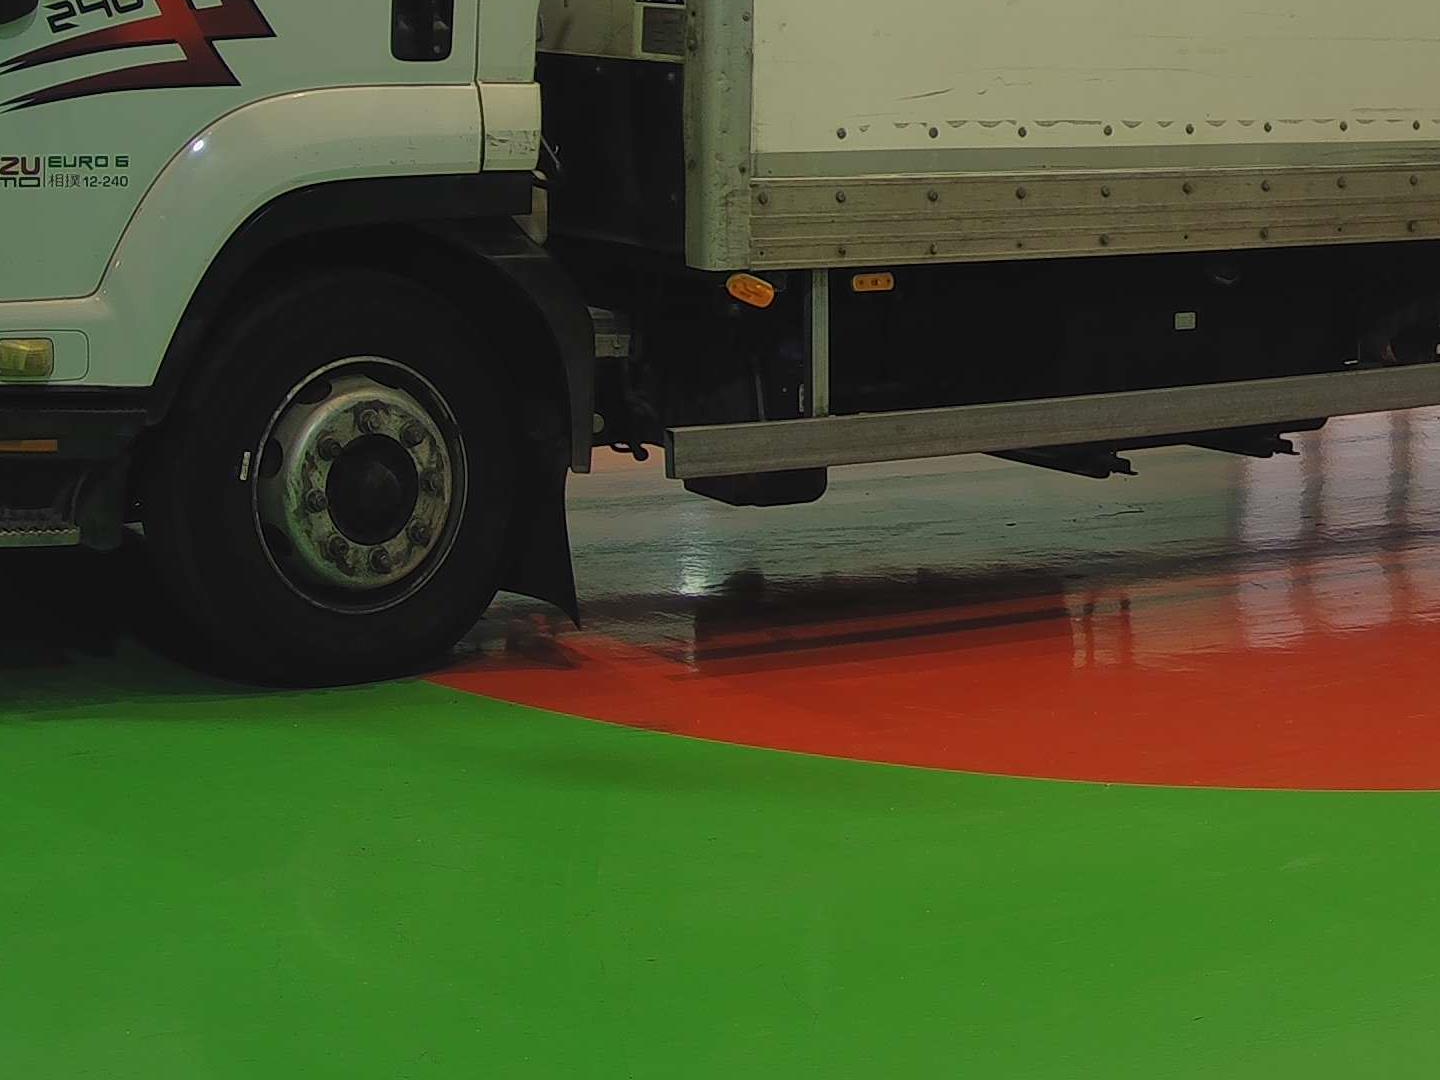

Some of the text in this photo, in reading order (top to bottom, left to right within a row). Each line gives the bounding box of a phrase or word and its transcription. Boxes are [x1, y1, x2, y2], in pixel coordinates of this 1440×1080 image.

[47, 155, 129, 170] EURO 6
[83, 175, 129, 188] 12-240
